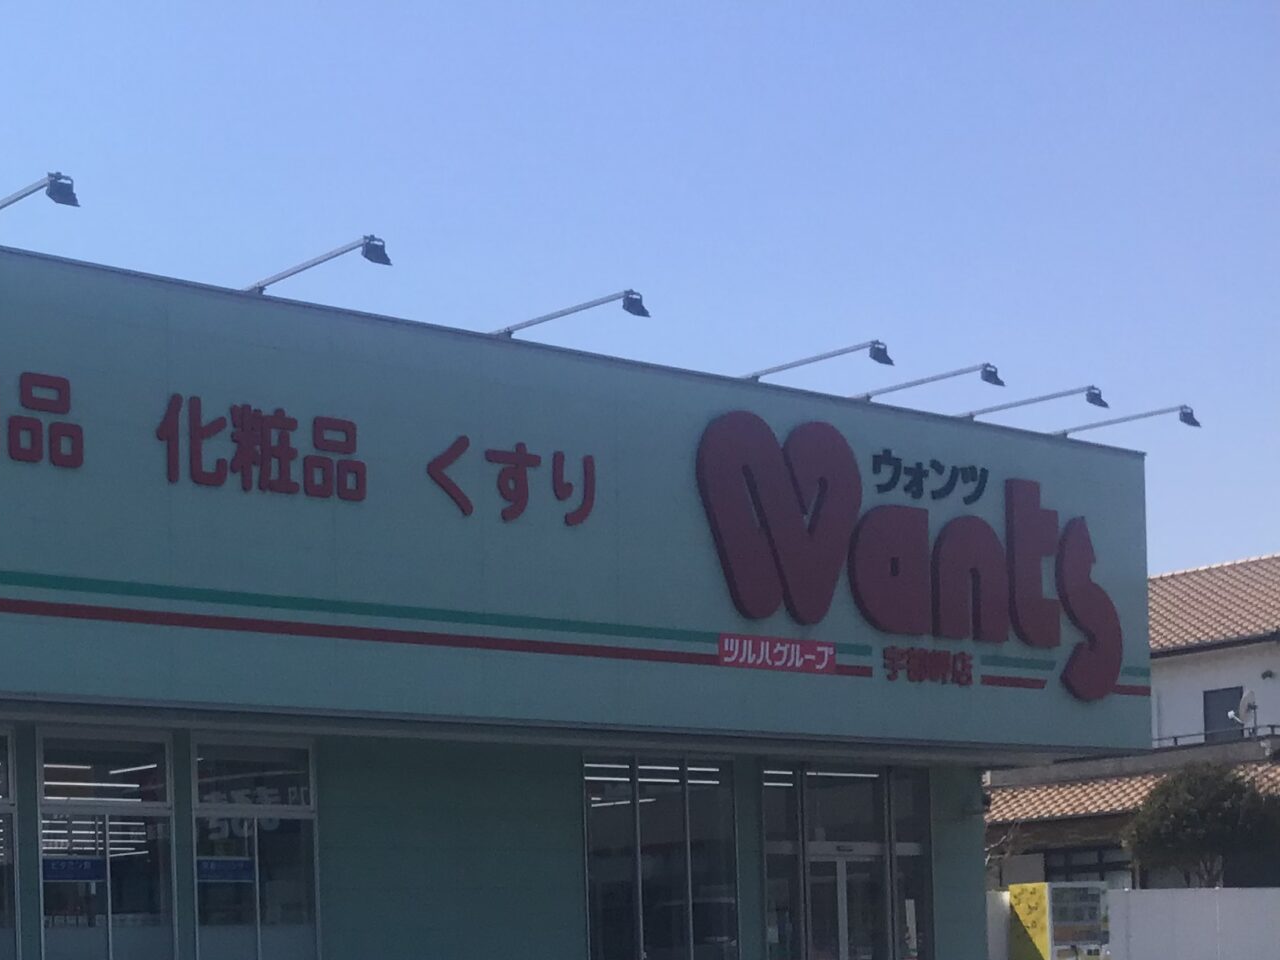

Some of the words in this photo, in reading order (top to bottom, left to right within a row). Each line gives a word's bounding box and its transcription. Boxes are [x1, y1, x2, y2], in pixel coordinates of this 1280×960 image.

[156, 393, 367, 502] 化粧品
[426, 435, 596, 526] くすり
[871, 449, 990, 505] ウォンツ
[695, 410, 1123, 702] Wants
[723, 638, 834, 669] ツルハグループ
